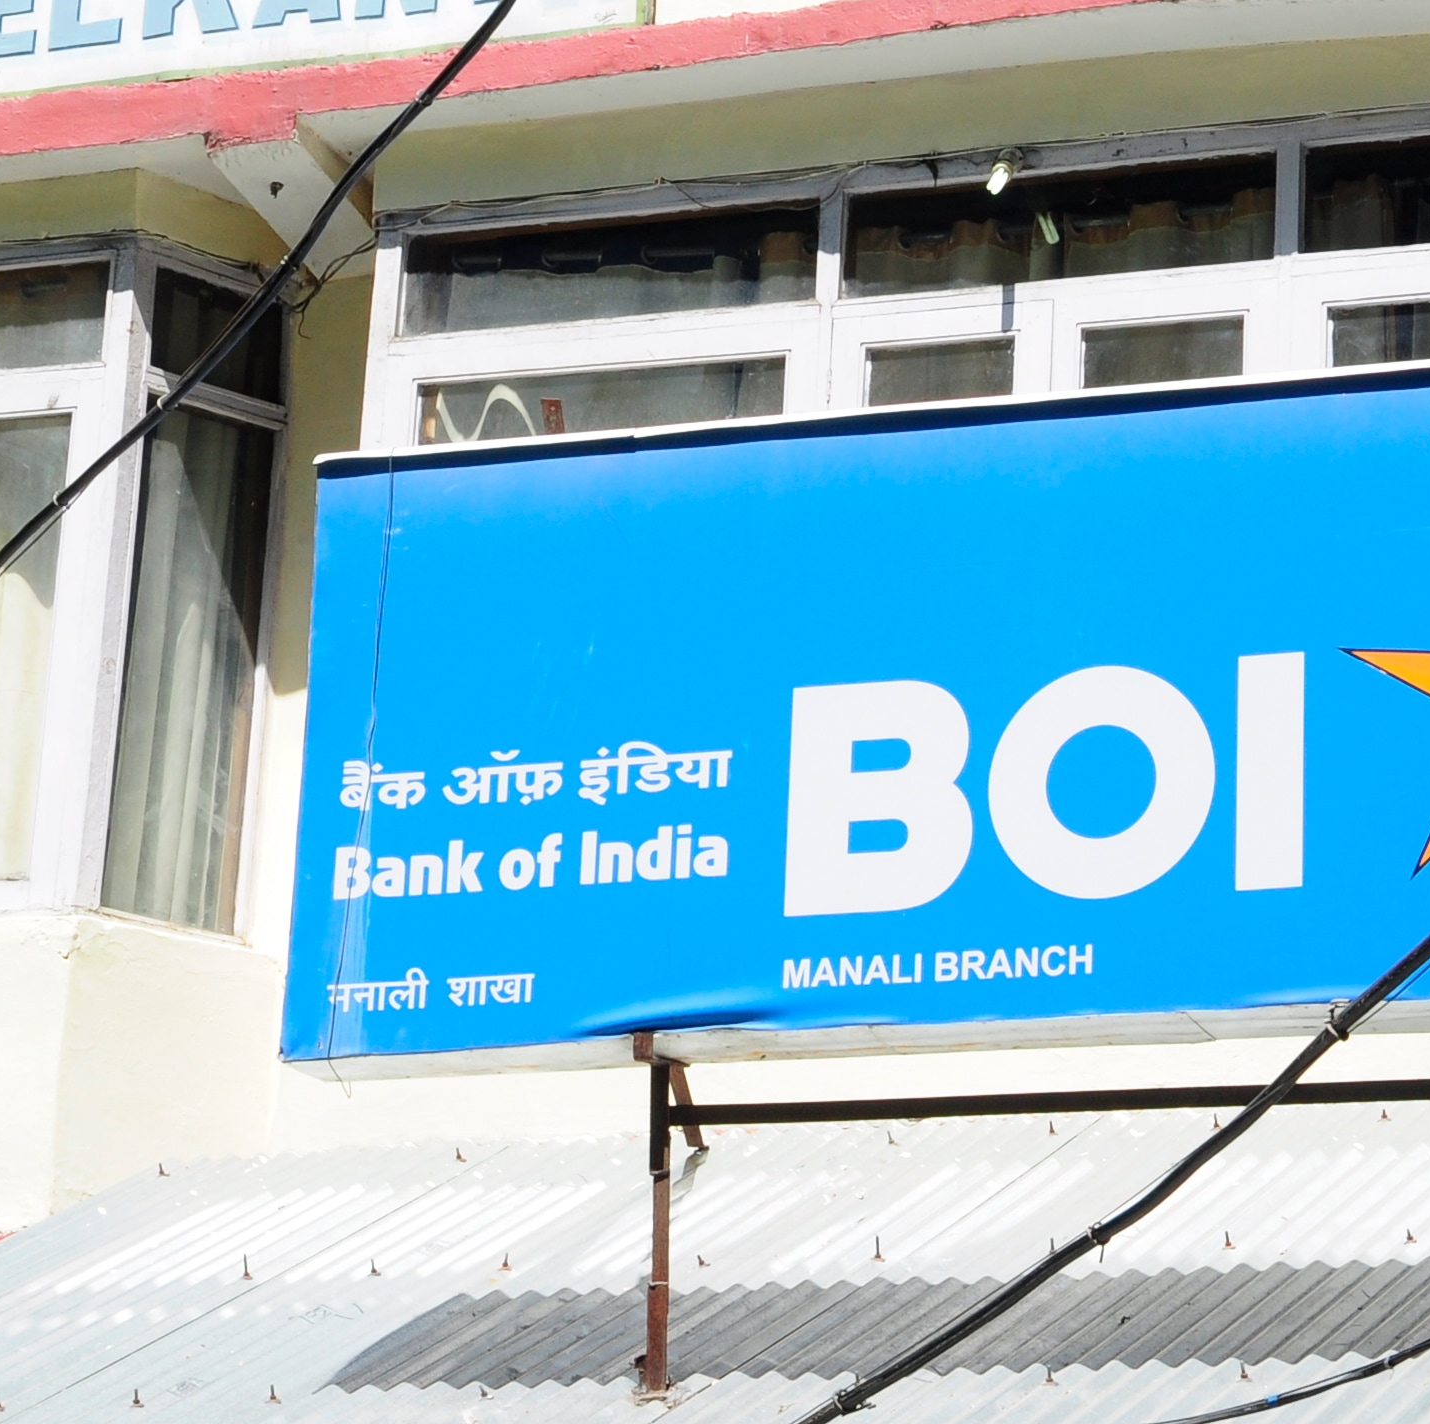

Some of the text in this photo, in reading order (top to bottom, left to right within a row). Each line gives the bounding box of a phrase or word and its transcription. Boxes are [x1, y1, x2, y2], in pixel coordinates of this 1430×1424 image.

[339, 760, 426, 811] बैंक
[578, 741, 733, 805] इंडिया
[784, 651, 1305, 917] BOI
[333, 824, 728, 900] Bank of India
[446, 973, 535, 1007] शाखा
[782, 944, 1094, 989] MANALI BRANCH
